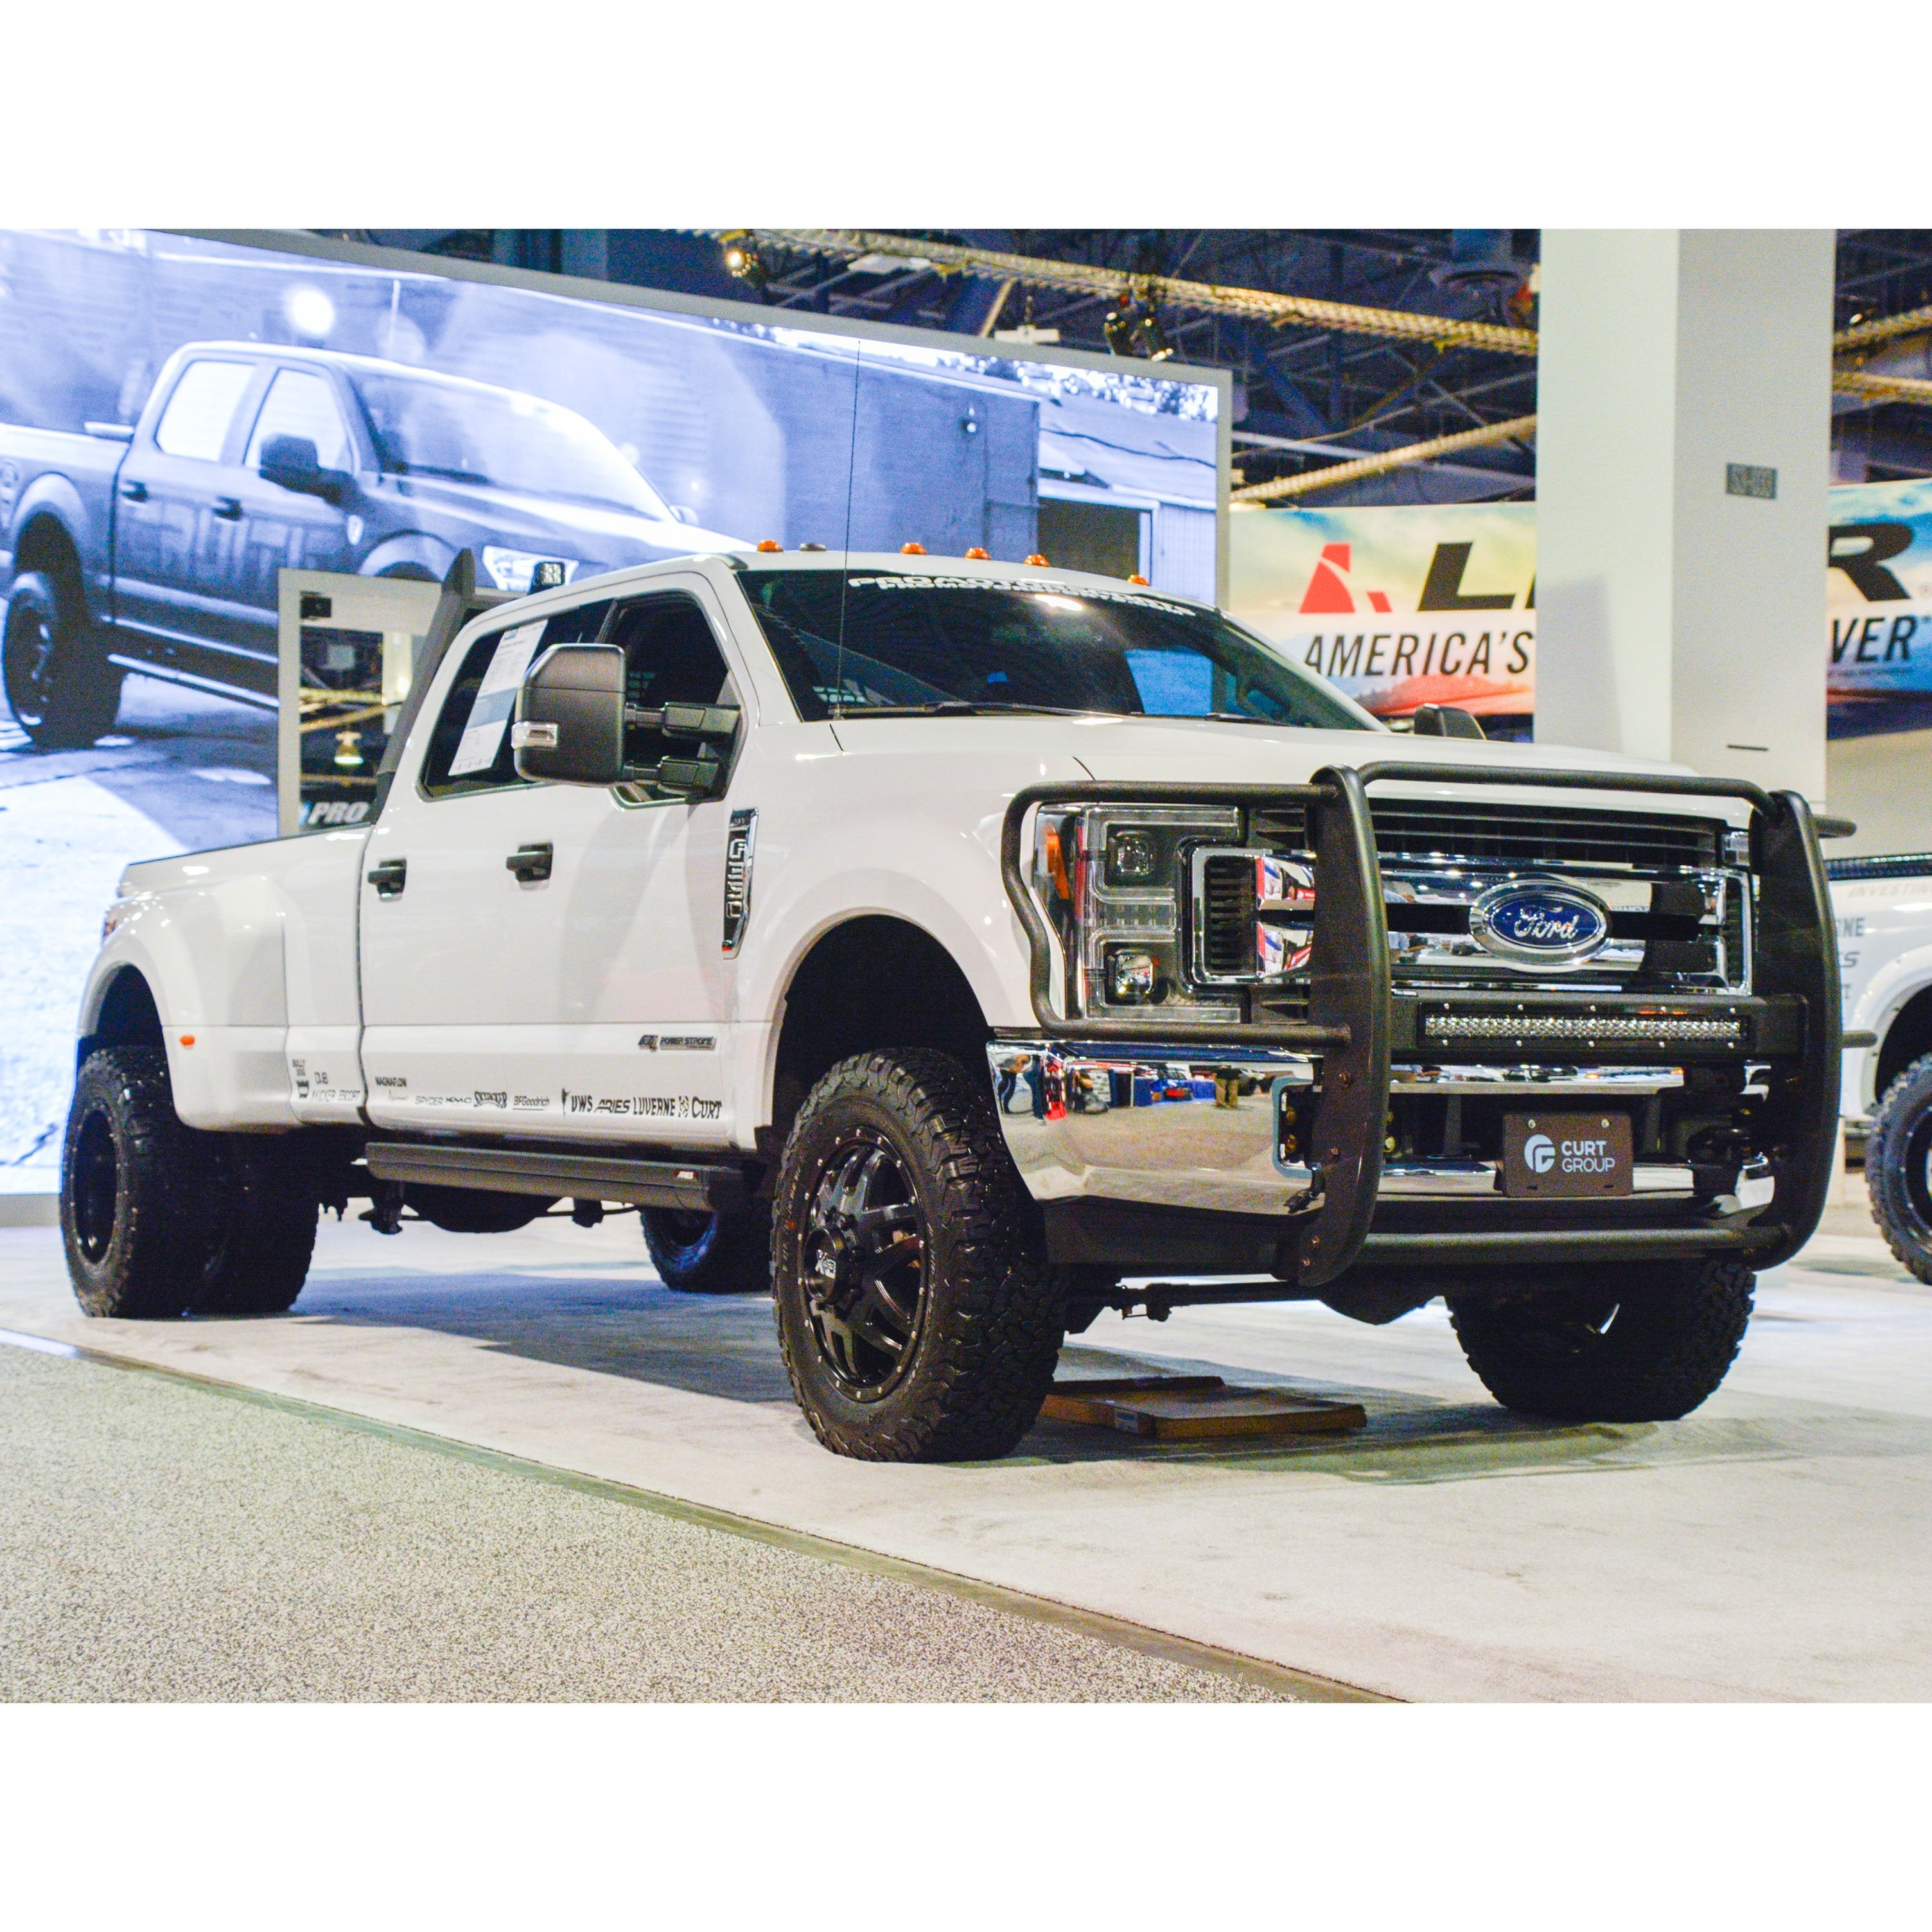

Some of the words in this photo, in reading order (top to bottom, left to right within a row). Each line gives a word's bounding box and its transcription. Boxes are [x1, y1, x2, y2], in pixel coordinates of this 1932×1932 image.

[1306, 631, 1534, 677] AMERICA'S
[1832, 615, 1917, 663] VER
[1513, 904, 1579, 939] Ford
[513, 1095, 550, 1107] BFGoodrich
[571, 1094, 593, 1112] UWS
[633, 1096, 676, 1116] LUVERNE
[692, 1096, 723, 1120] CURT
[1561, 1140, 1607, 1156] CURT
[1561, 1157, 1615, 1173] GROUP
